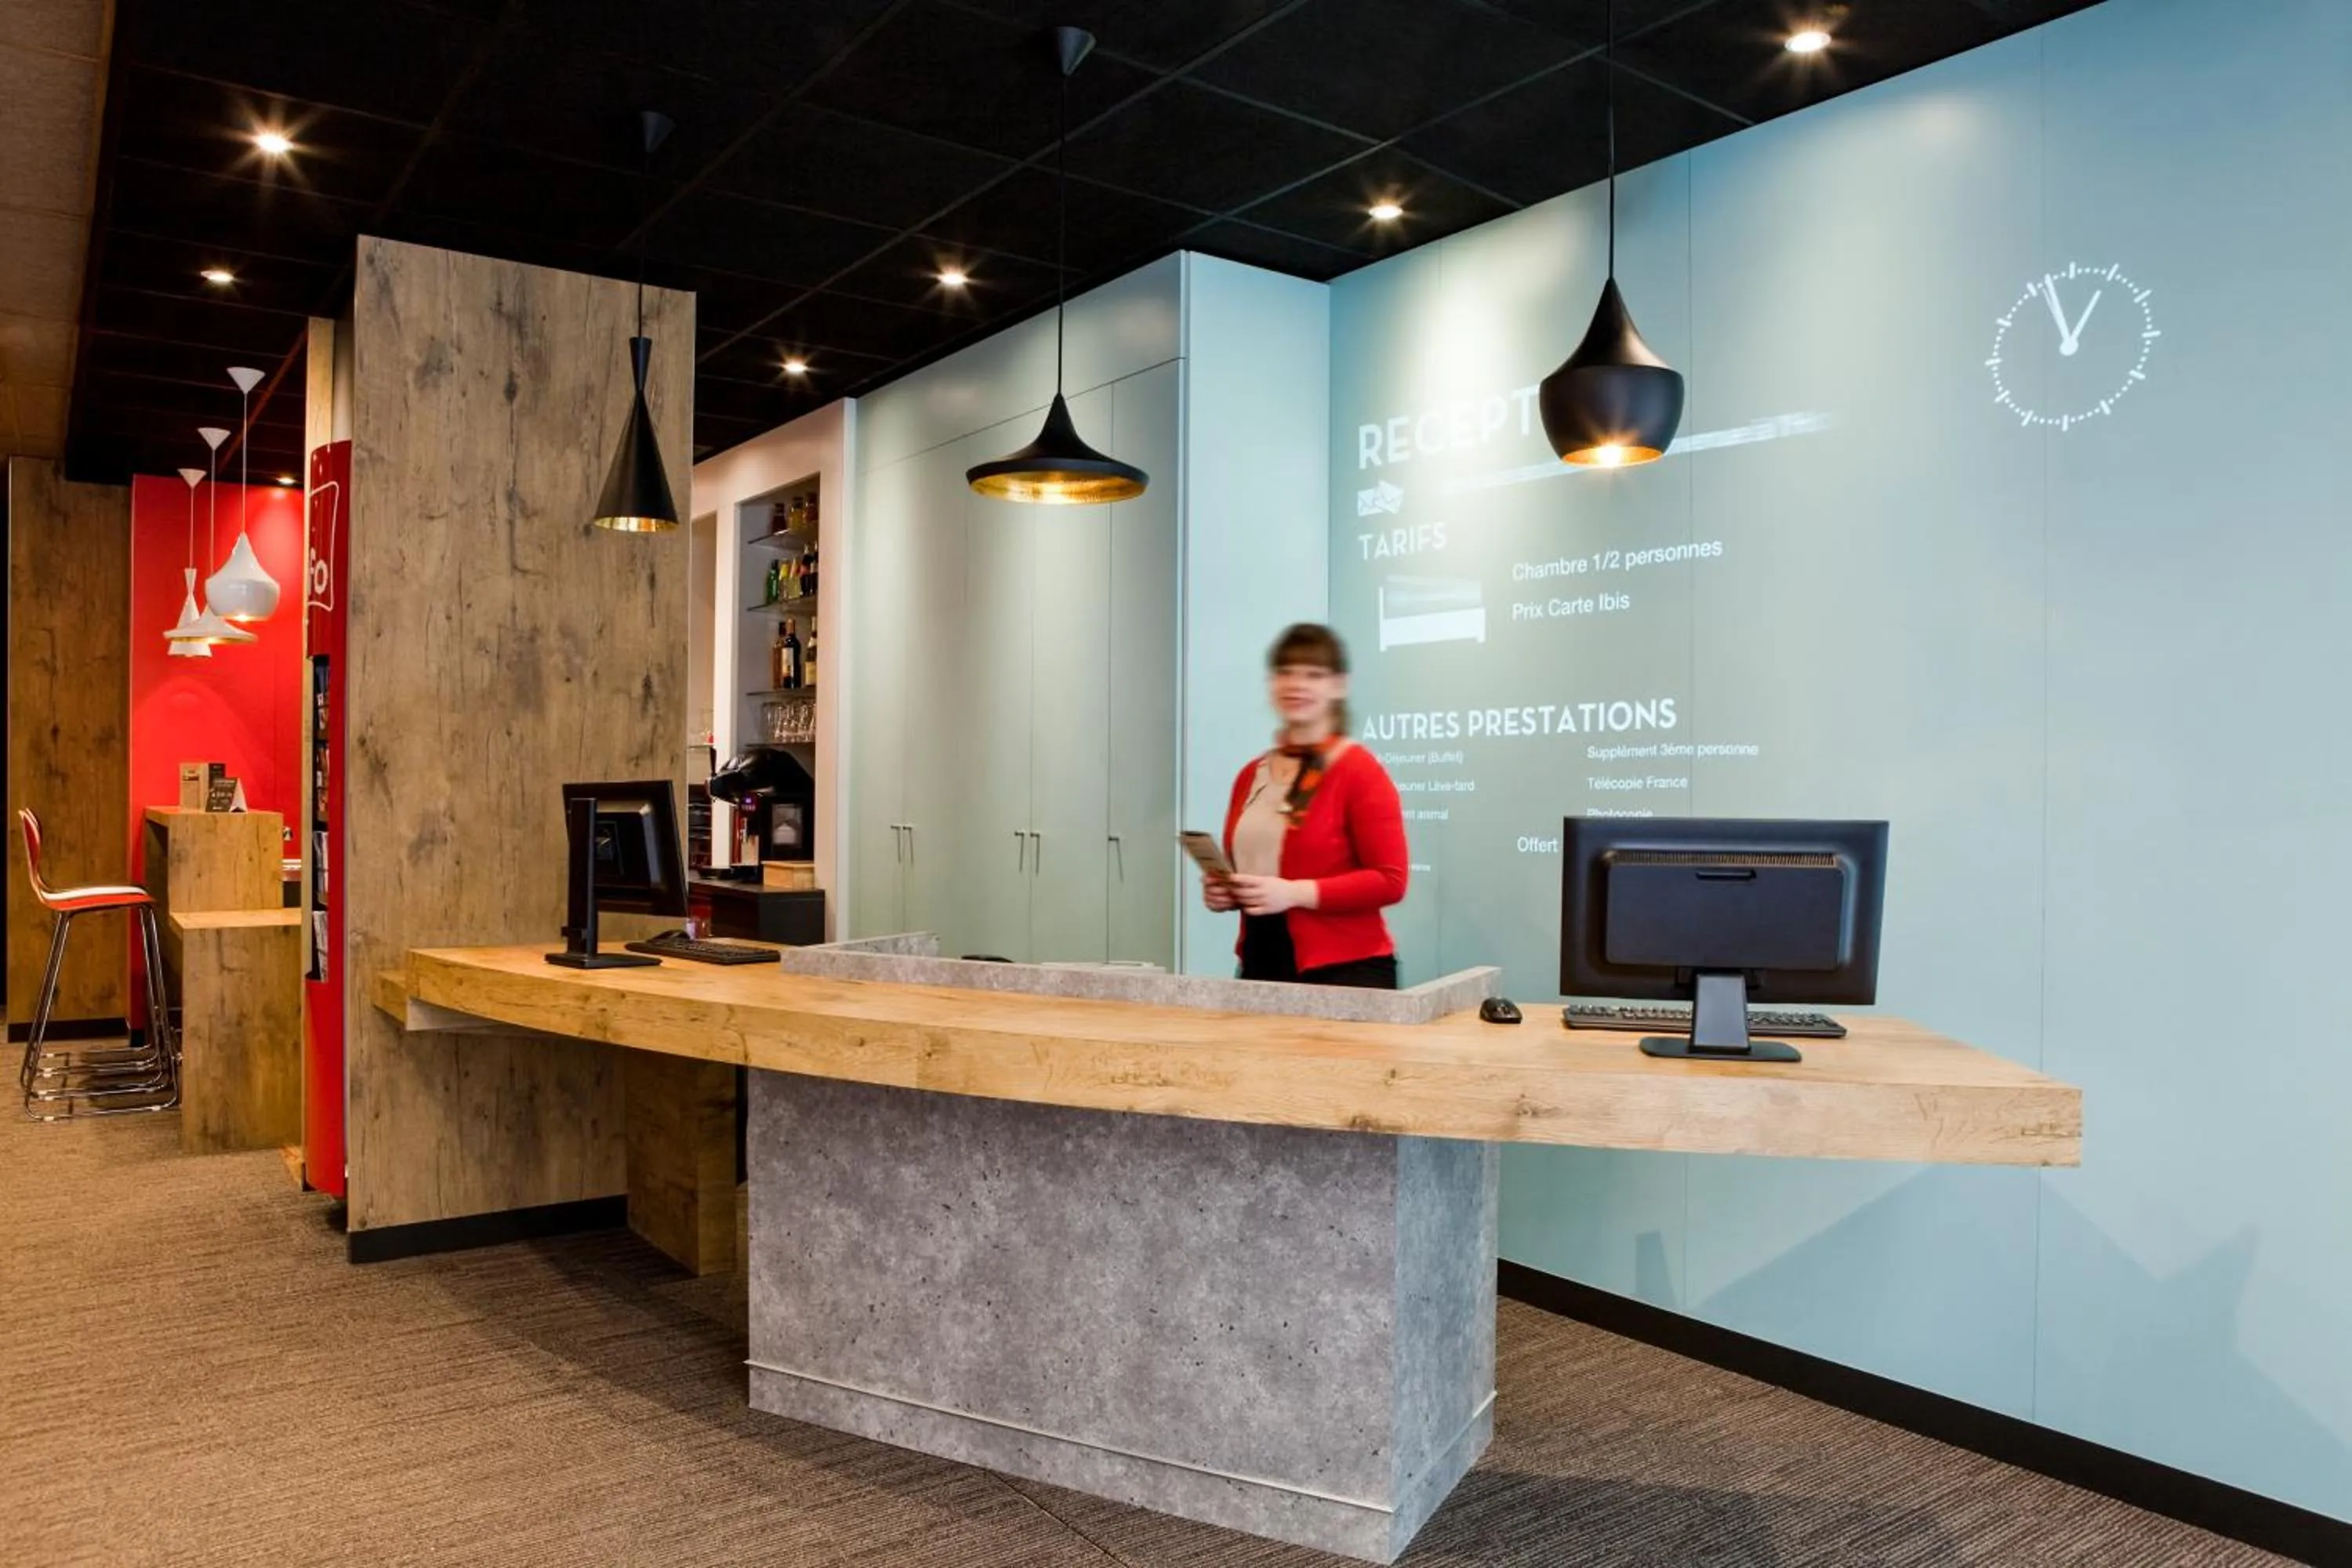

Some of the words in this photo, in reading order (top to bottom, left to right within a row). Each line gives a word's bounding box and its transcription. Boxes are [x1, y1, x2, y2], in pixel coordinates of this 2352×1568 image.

[1358, 521, 1447, 561] TARIFS
[1512, 555, 1588, 582] Chambre
[1592, 550, 1621, 572] 1/2
[1625, 539, 1723, 572] personnes
[1512, 602, 1544, 621] Prix
[1548, 596, 1594, 617] Carte
[1599, 591, 1631, 612] Ibis
[1362, 710, 1461, 742] AUTRES
[1468, 697, 1678, 739] PRESTATIONS
[1697, 744, 1759, 759] personne
[1646, 774, 1689, 789] France
[1516, 836, 1559, 854] Offert
